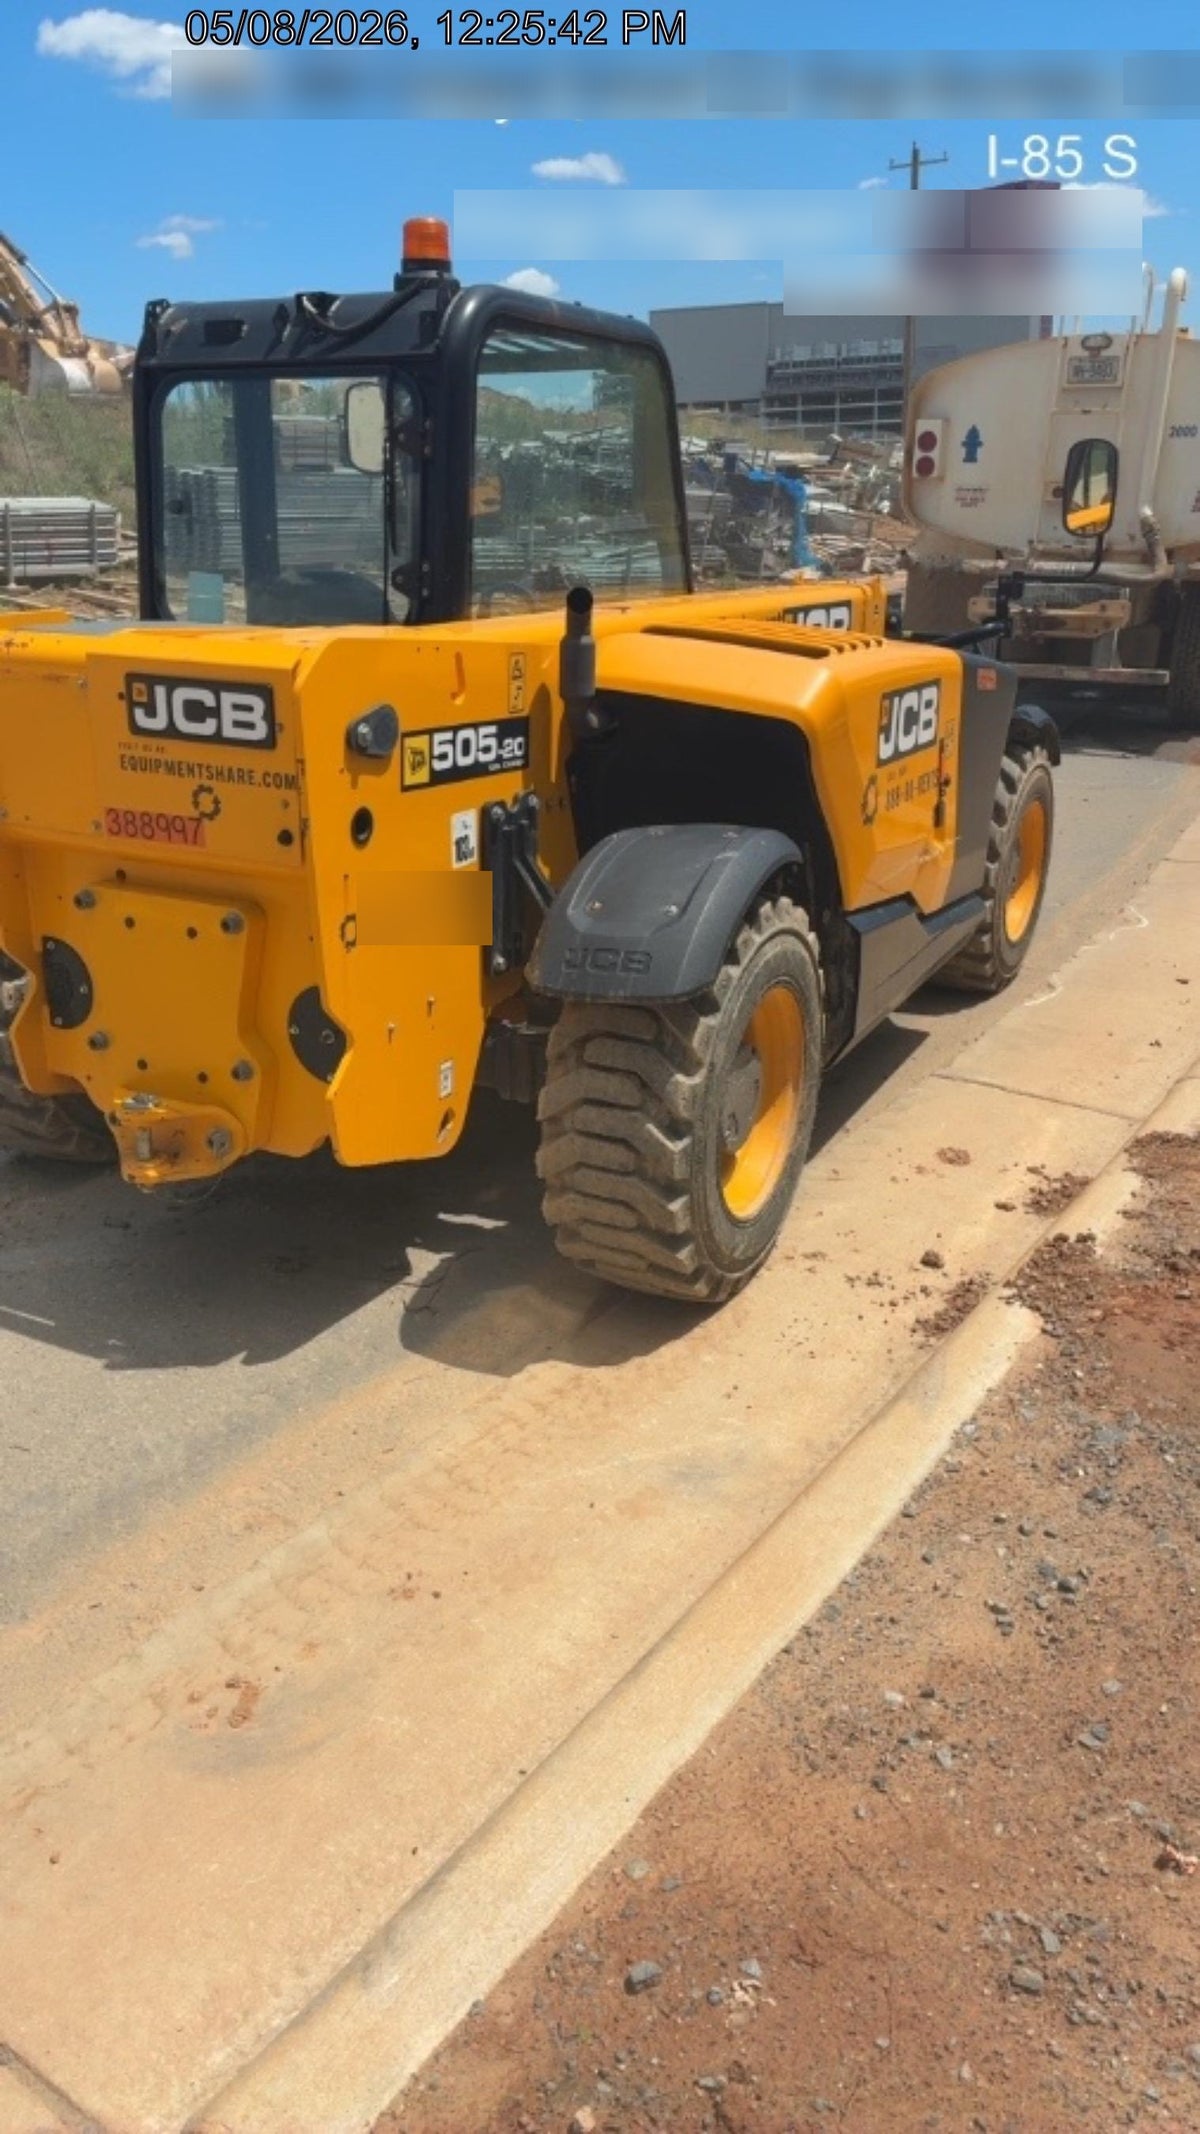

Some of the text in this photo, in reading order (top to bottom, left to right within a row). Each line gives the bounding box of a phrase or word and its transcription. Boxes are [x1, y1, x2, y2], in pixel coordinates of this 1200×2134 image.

[133, 685, 269, 741] JCB
[879, 684, 938, 760] JCB
[431, 725, 525, 771] 505-20
[120, 753, 299, 791] EQUIPMENTSHARE.COM
[106, 807, 204, 846] 388997
[561, 947, 653, 976] JCB
